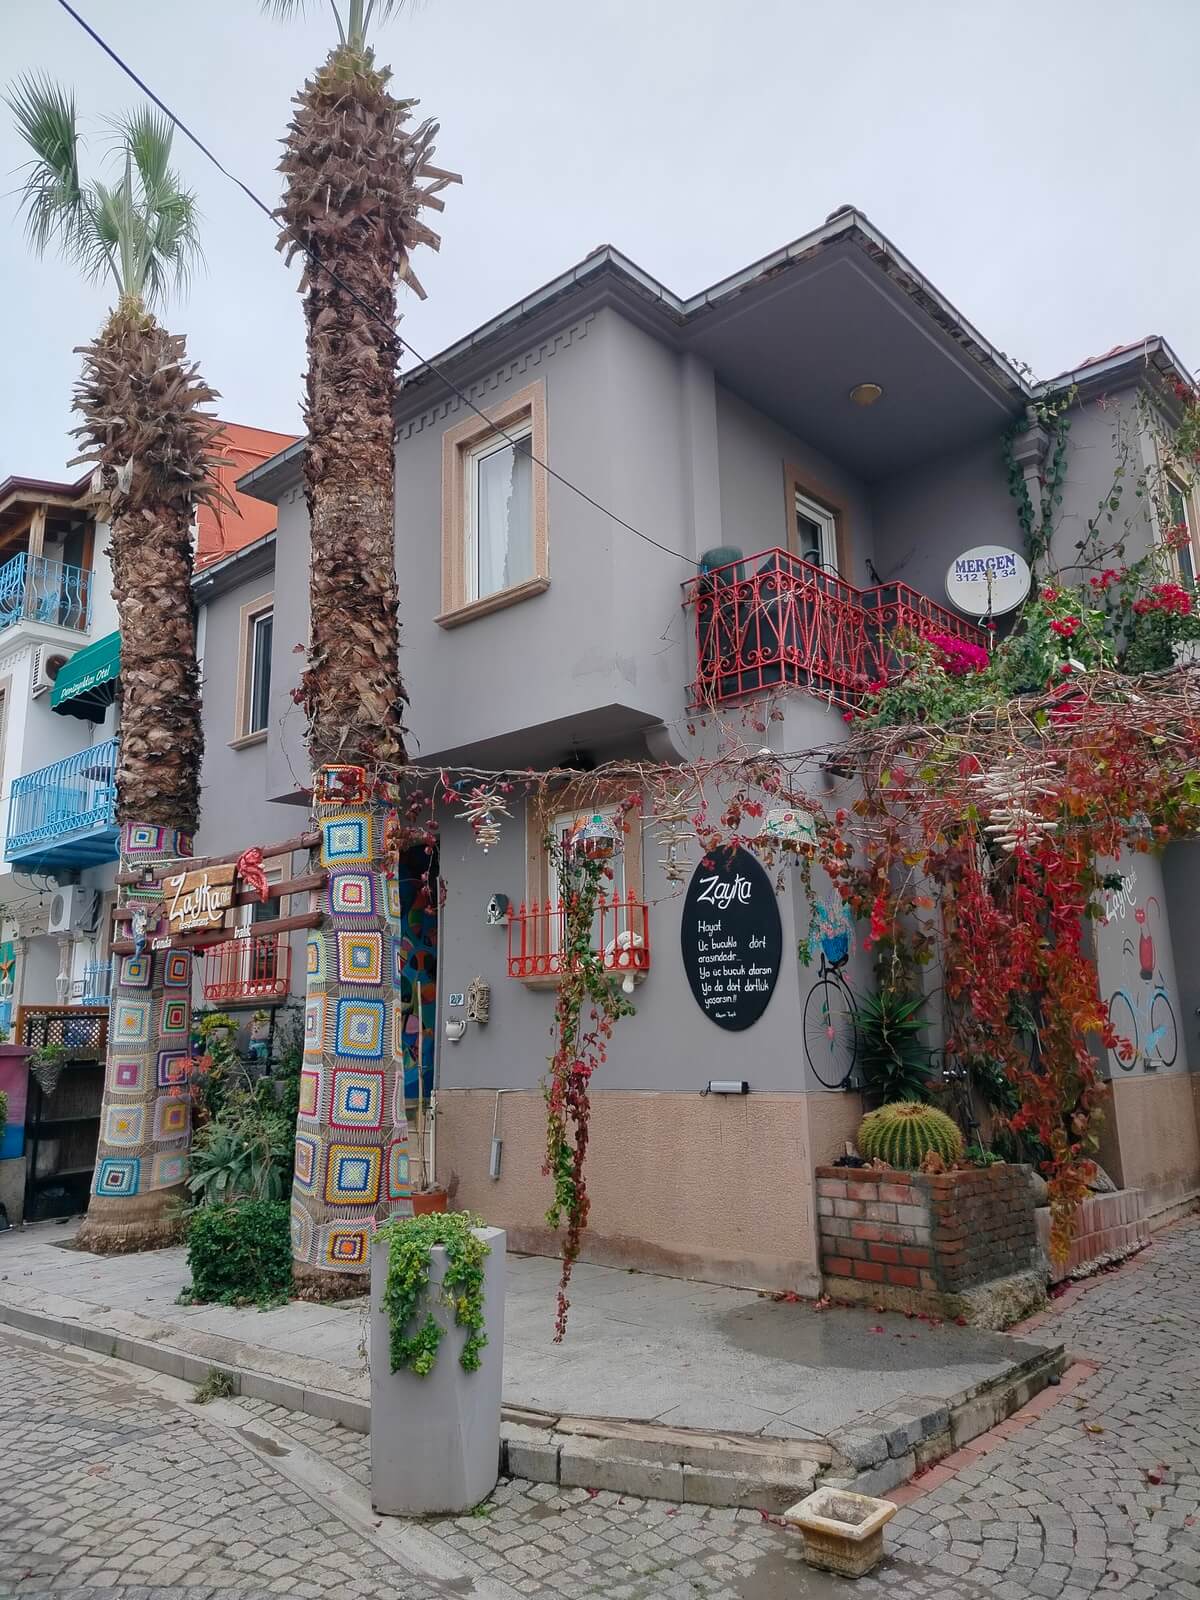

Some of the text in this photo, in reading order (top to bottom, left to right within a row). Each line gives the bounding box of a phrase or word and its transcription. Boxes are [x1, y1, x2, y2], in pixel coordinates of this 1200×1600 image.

[955, 553, 1016, 573] MERGEN
[956, 573, 979, 583] 312
[1001, 567, 1016, 578] 34
[697, 873, 752, 909] Zayka
[698, 920, 721, 937] Hayat
[699, 966, 711, 980] Ya
[702, 982, 712, 996] Ya
[714, 979, 724, 992] da
